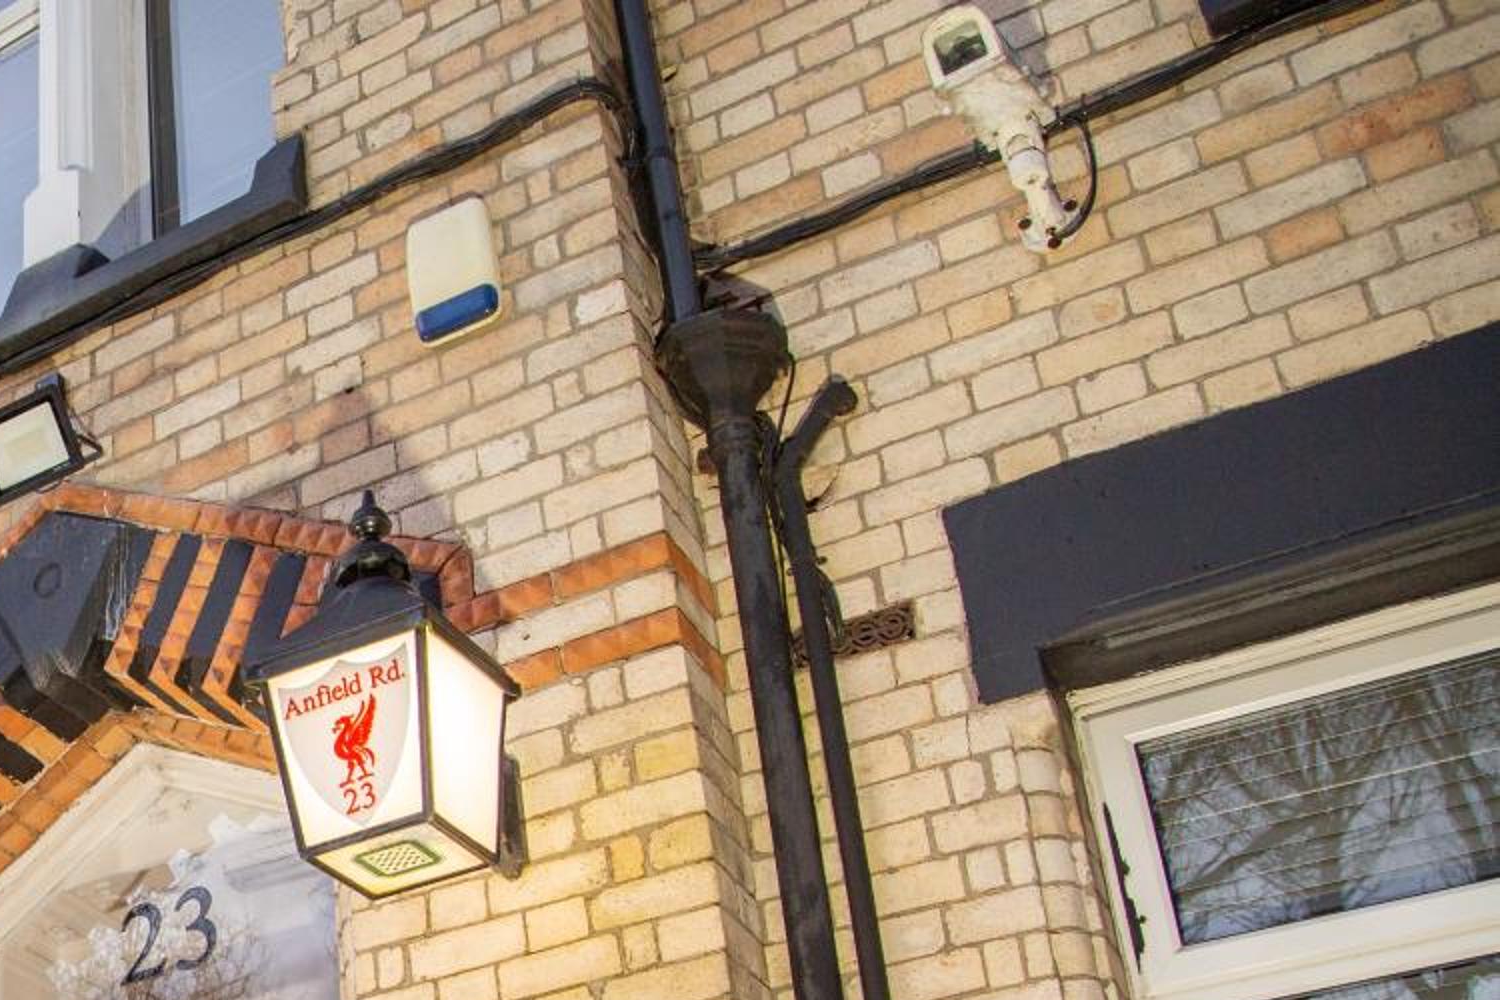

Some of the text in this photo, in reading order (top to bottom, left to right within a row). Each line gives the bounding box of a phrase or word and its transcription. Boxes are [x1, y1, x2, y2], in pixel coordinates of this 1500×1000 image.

[284, 657, 407, 720] Anfield Rd.
[342, 782, 376, 815] 23
[120, 885, 217, 987] 23
